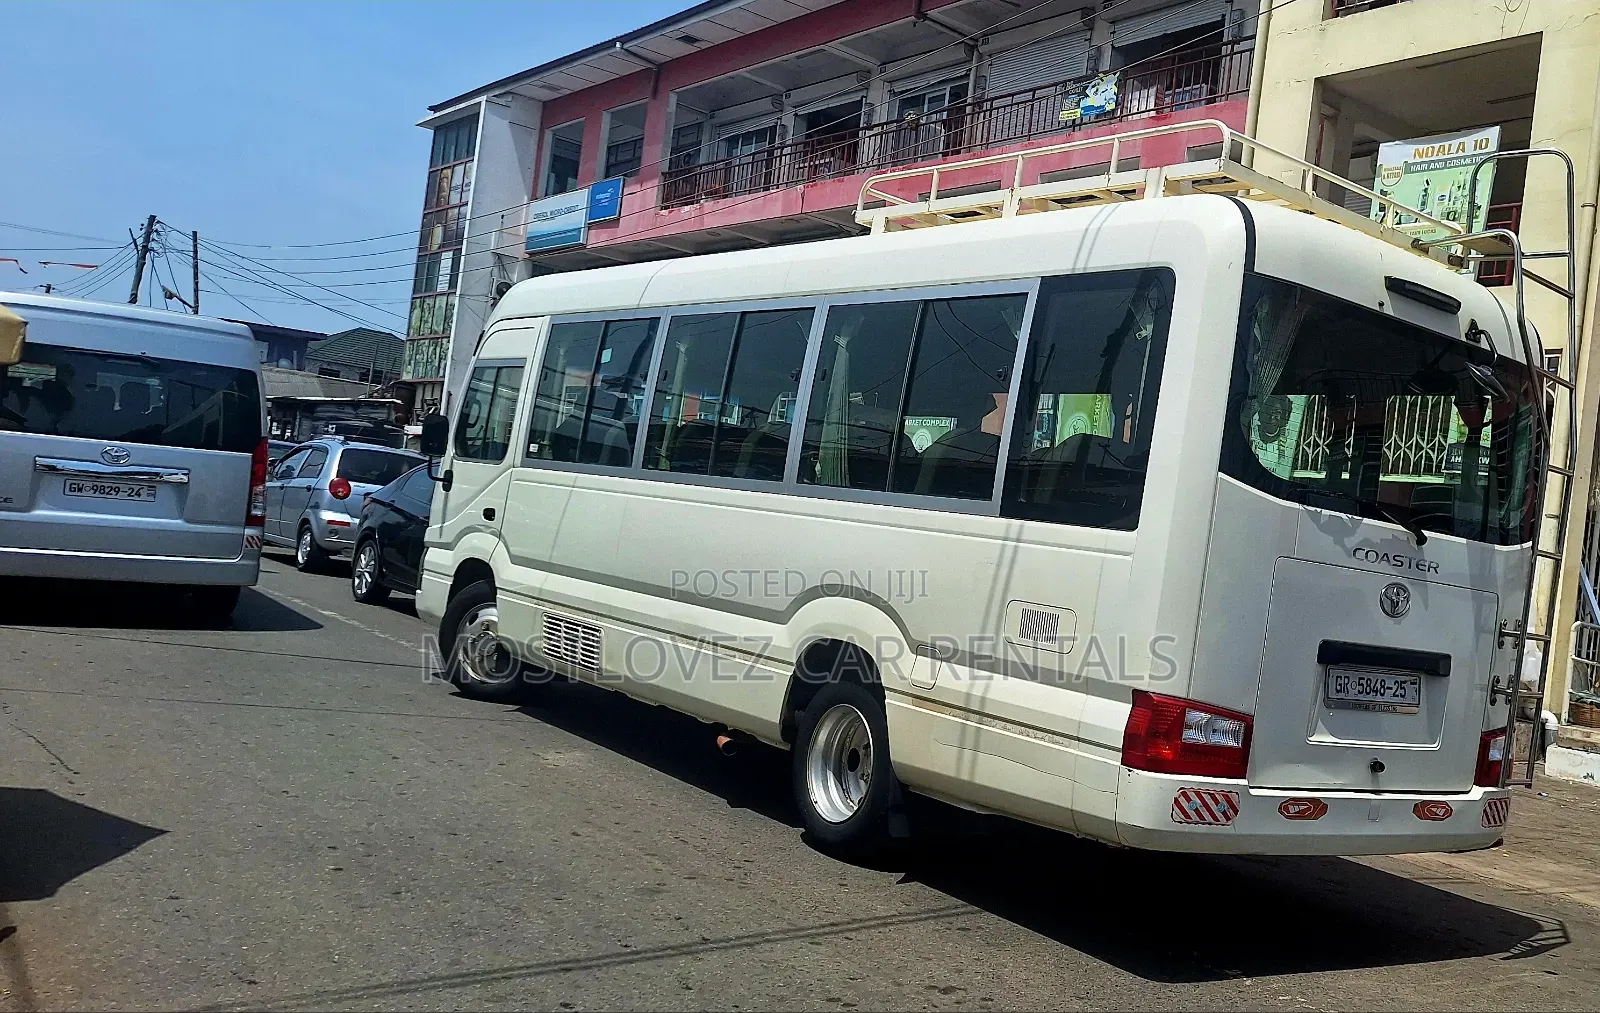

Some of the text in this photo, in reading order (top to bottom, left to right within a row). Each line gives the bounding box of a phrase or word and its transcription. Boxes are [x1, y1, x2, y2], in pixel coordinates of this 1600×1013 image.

[1413, 137, 1490, 160] NOALA 10
[1410, 164, 1428, 172] HAIR
[1429, 162, 1445, 171] AND
[69, 482, 144, 498] GW 9829-24
[1352, 547, 1440, 574] COASTER
[1335, 675, 1407, 698] GR 5848-25
